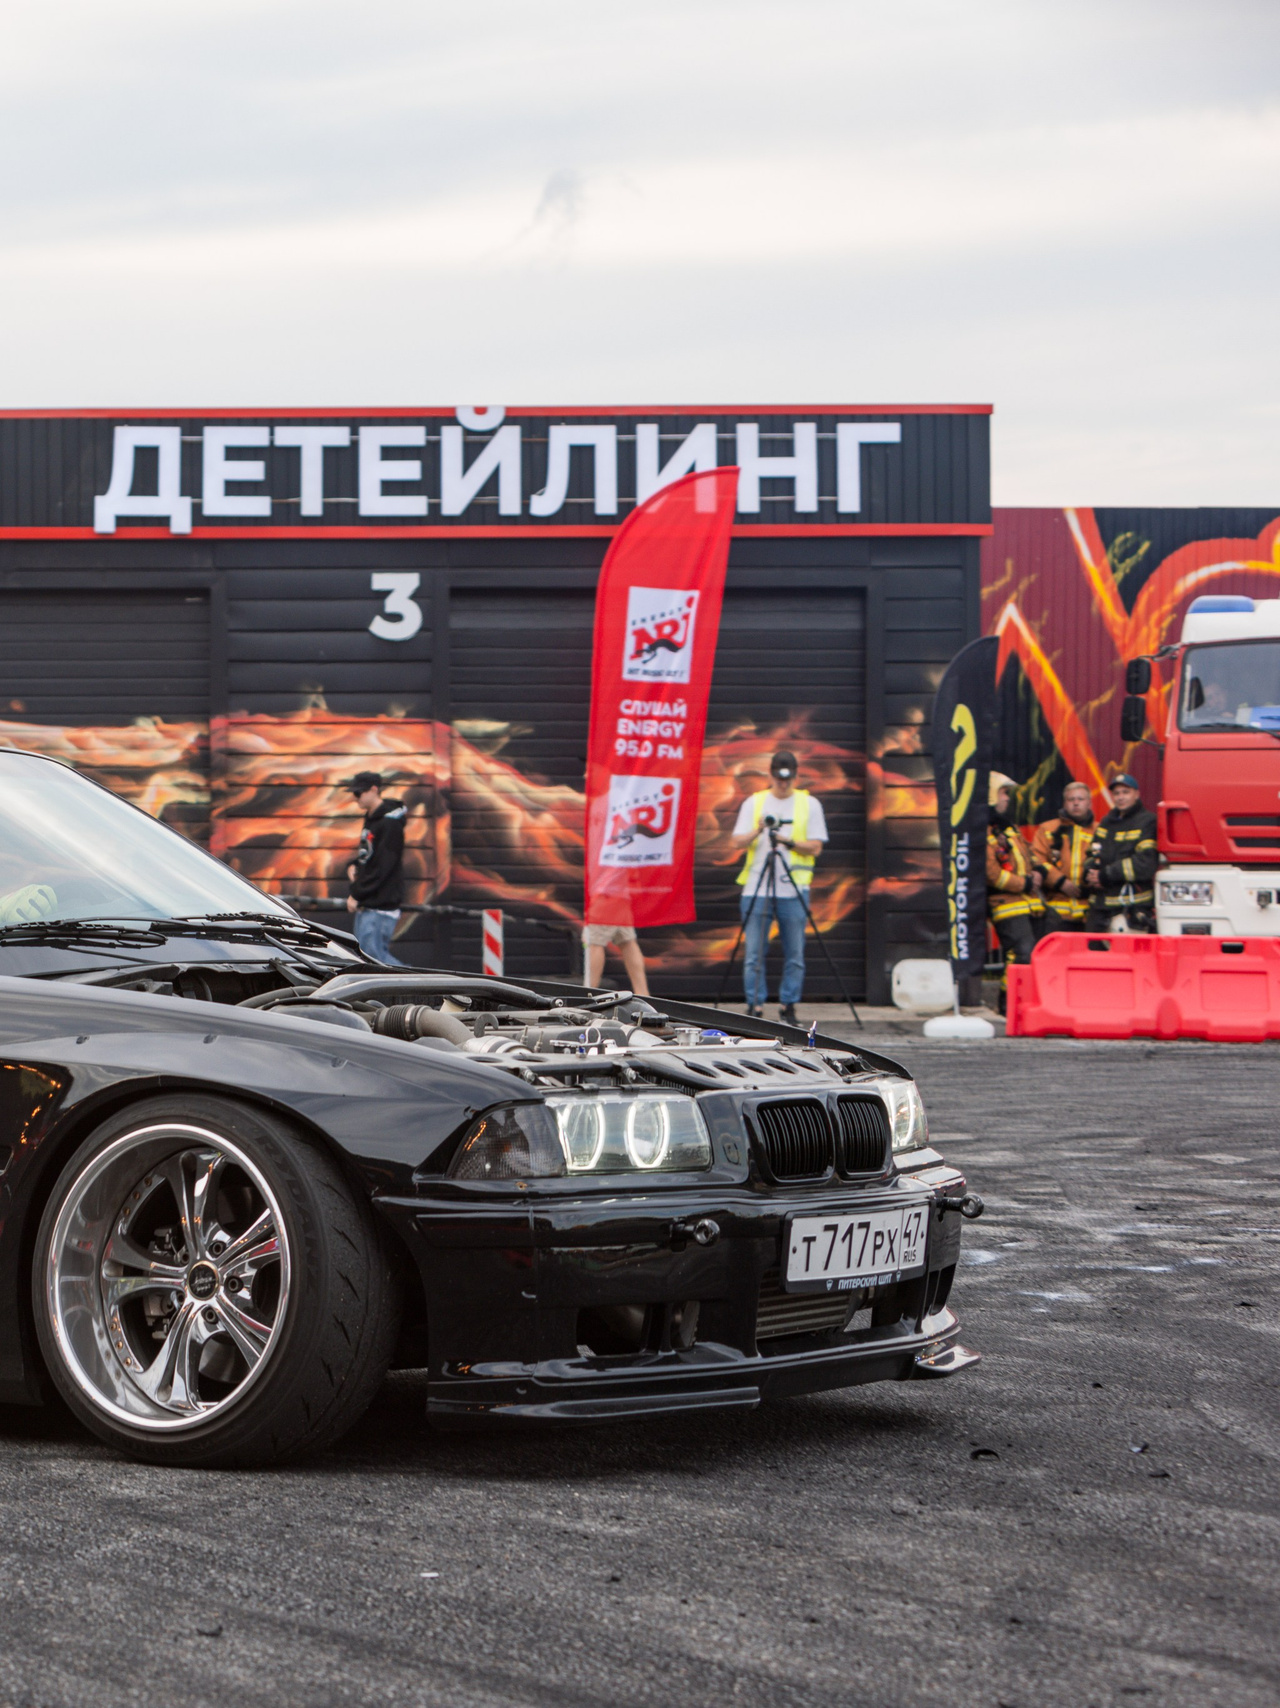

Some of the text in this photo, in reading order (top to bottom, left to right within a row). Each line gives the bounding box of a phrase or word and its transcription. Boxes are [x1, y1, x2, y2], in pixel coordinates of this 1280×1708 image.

[93, 405, 902, 535] ДЕТЕЙЛИНГ
[368, 572, 423, 641] 3
[617, 717, 685, 738] ENERGY
[657, 744, 684, 760] FM
[956, 832, 969, 960] MOTOR OIL
[903, 1249, 918, 1263] RUS
[838, 1275, 877, 1290] ПИТЕРСКИЙ
